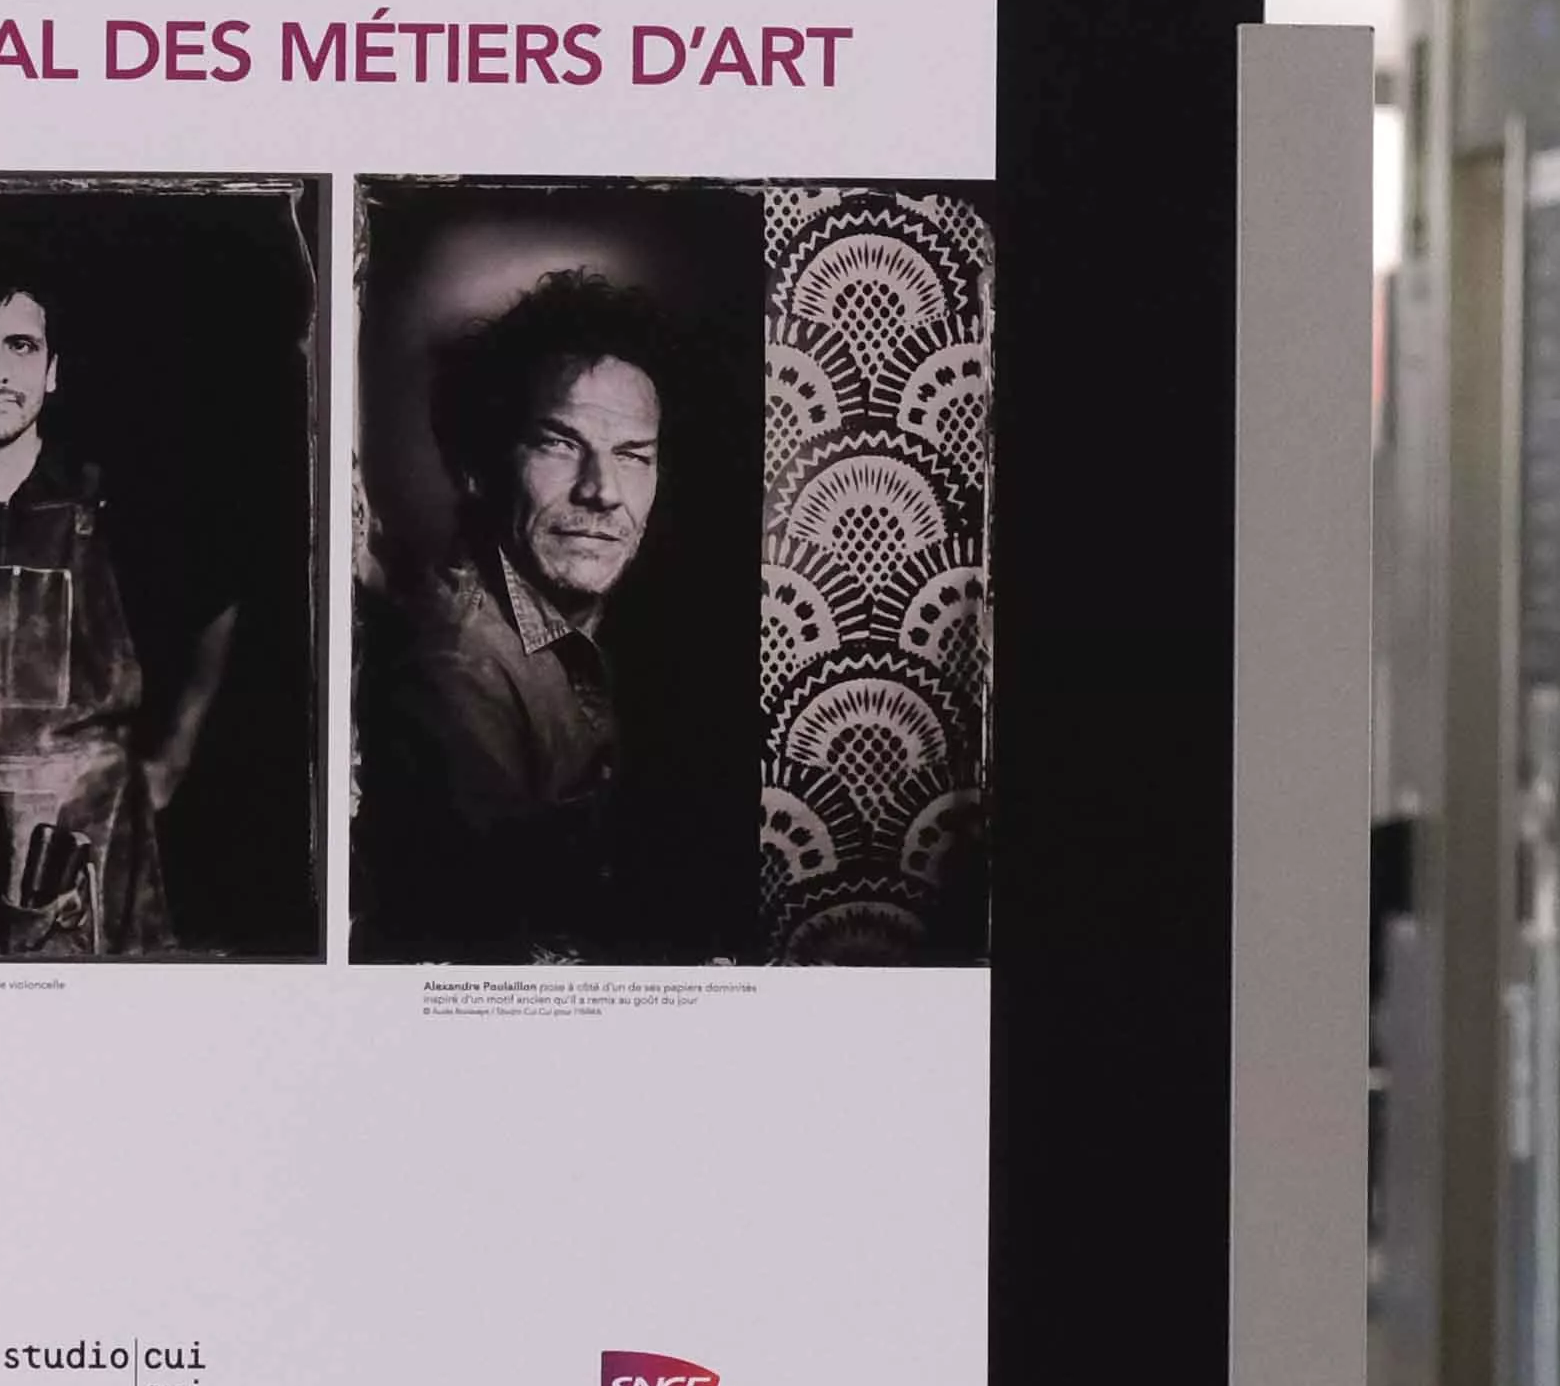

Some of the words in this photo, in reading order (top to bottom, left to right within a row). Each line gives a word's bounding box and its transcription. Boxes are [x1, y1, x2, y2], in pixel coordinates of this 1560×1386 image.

[106, 20, 251, 82] DES
[282, 7, 602, 85] MÉTIERS
[632, 25, 853, 87] D'ART
[4, 1340, 129, 1369] studio
[144, 1341, 206, 1369] cui
